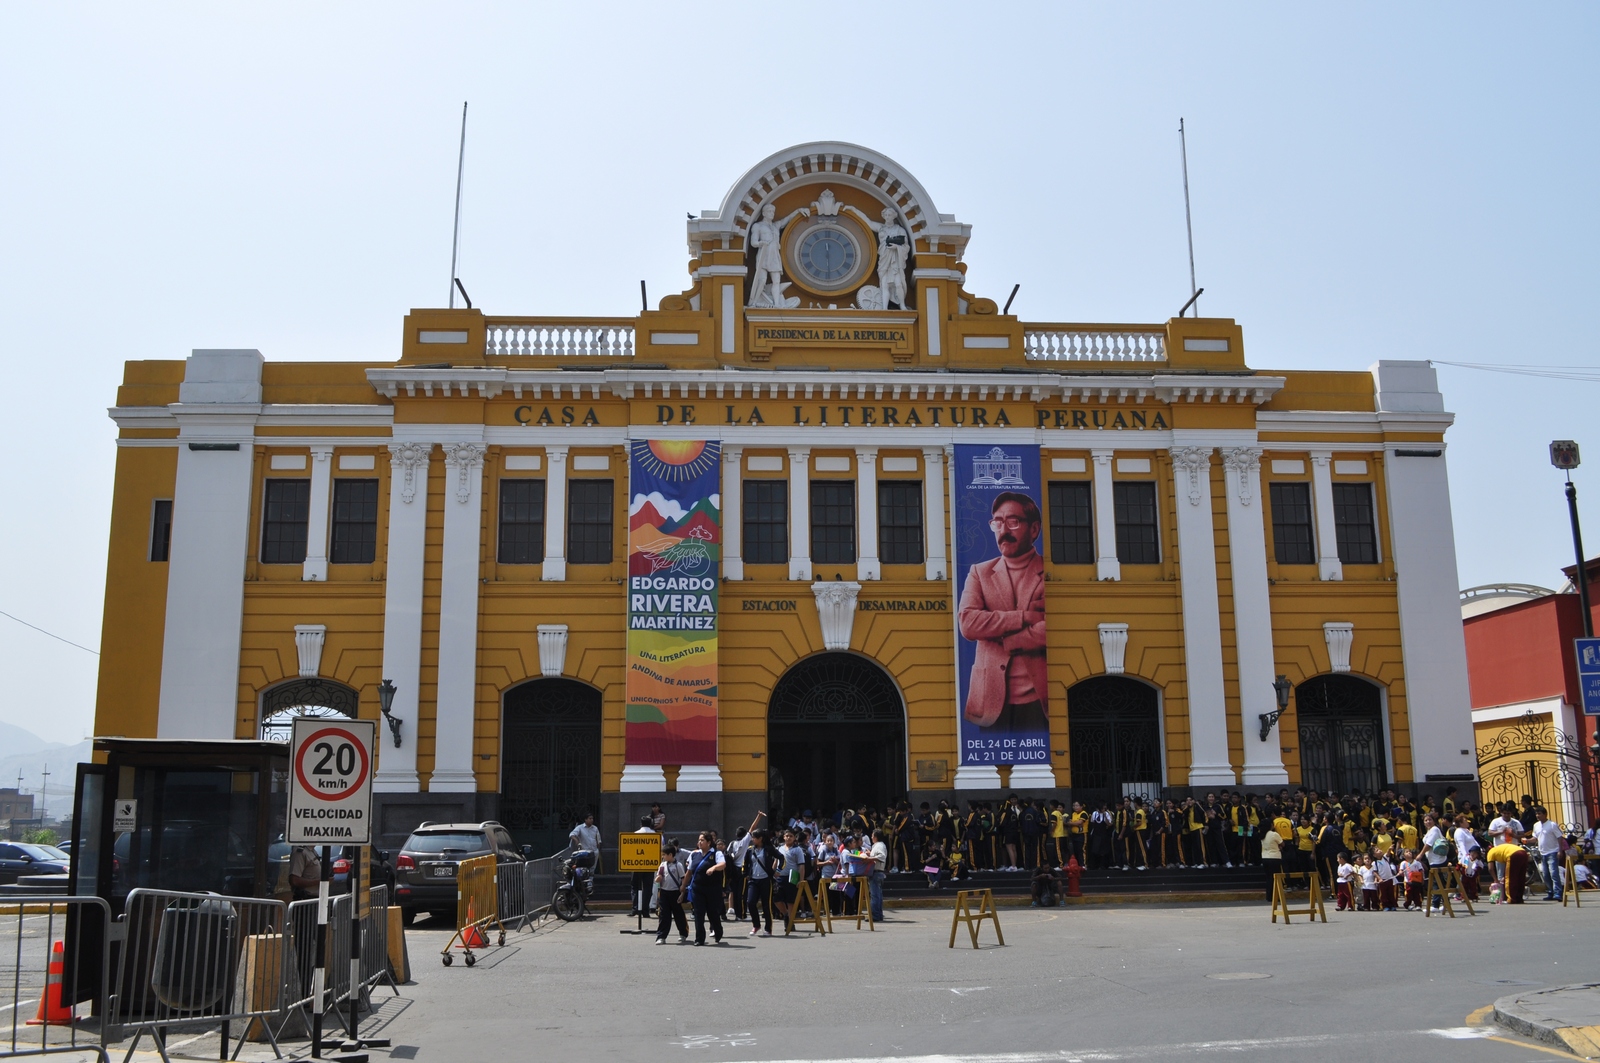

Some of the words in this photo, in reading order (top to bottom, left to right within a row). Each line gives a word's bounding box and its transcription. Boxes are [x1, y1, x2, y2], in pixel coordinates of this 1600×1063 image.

[757, 329, 820, 340] PRESIDENCIA
[823, 330, 835, 340] DE
[838, 330, 851, 340] LA
[854, 330, 906, 341] REPUBLICA
[513, 405, 601, 424] CASA
[656, 404, 696, 423] DE
[725, 405, 765, 423] LA
[793, 406, 1011, 426] LITERATURA
[1037, 409, 1169, 429] PERUANA
[632, 576, 715, 591] EDGARDO
[631, 594, 714, 612] RIVERA
[741, 600, 797, 611] ESTACION
[859, 600, 947, 611] DESAMPARADOS
[631, 613, 714, 629] MARTÍNEZ
[639, 651, 657, 661] UNA
[659, 646, 706, 662] LITERATURA
[631, 663, 663, 682] ANDINA
[664, 677, 675, 685] DE
[676, 678, 713, 687] AMARUS,
[630, 696, 673, 704] UNICORNIOS
[682, 695, 713, 707] ÁNGELES
[967, 740, 985, 749] DEL
[988, 739, 1000, 748] 24
[1003, 739, 1016, 748] DE
[1019, 738, 1046, 748] ABRIL
[312, 742, 356, 776] 20
[967, 752, 980, 761] AL
[984, 752, 995, 760] 21
[1000, 751, 1013, 760] DE
[1018, 750, 1046, 760] JULIO
[318, 778, 348, 789] km/h
[294, 808, 363, 819] VELOCIDAD
[303, 826, 353, 837] MAXIMA
